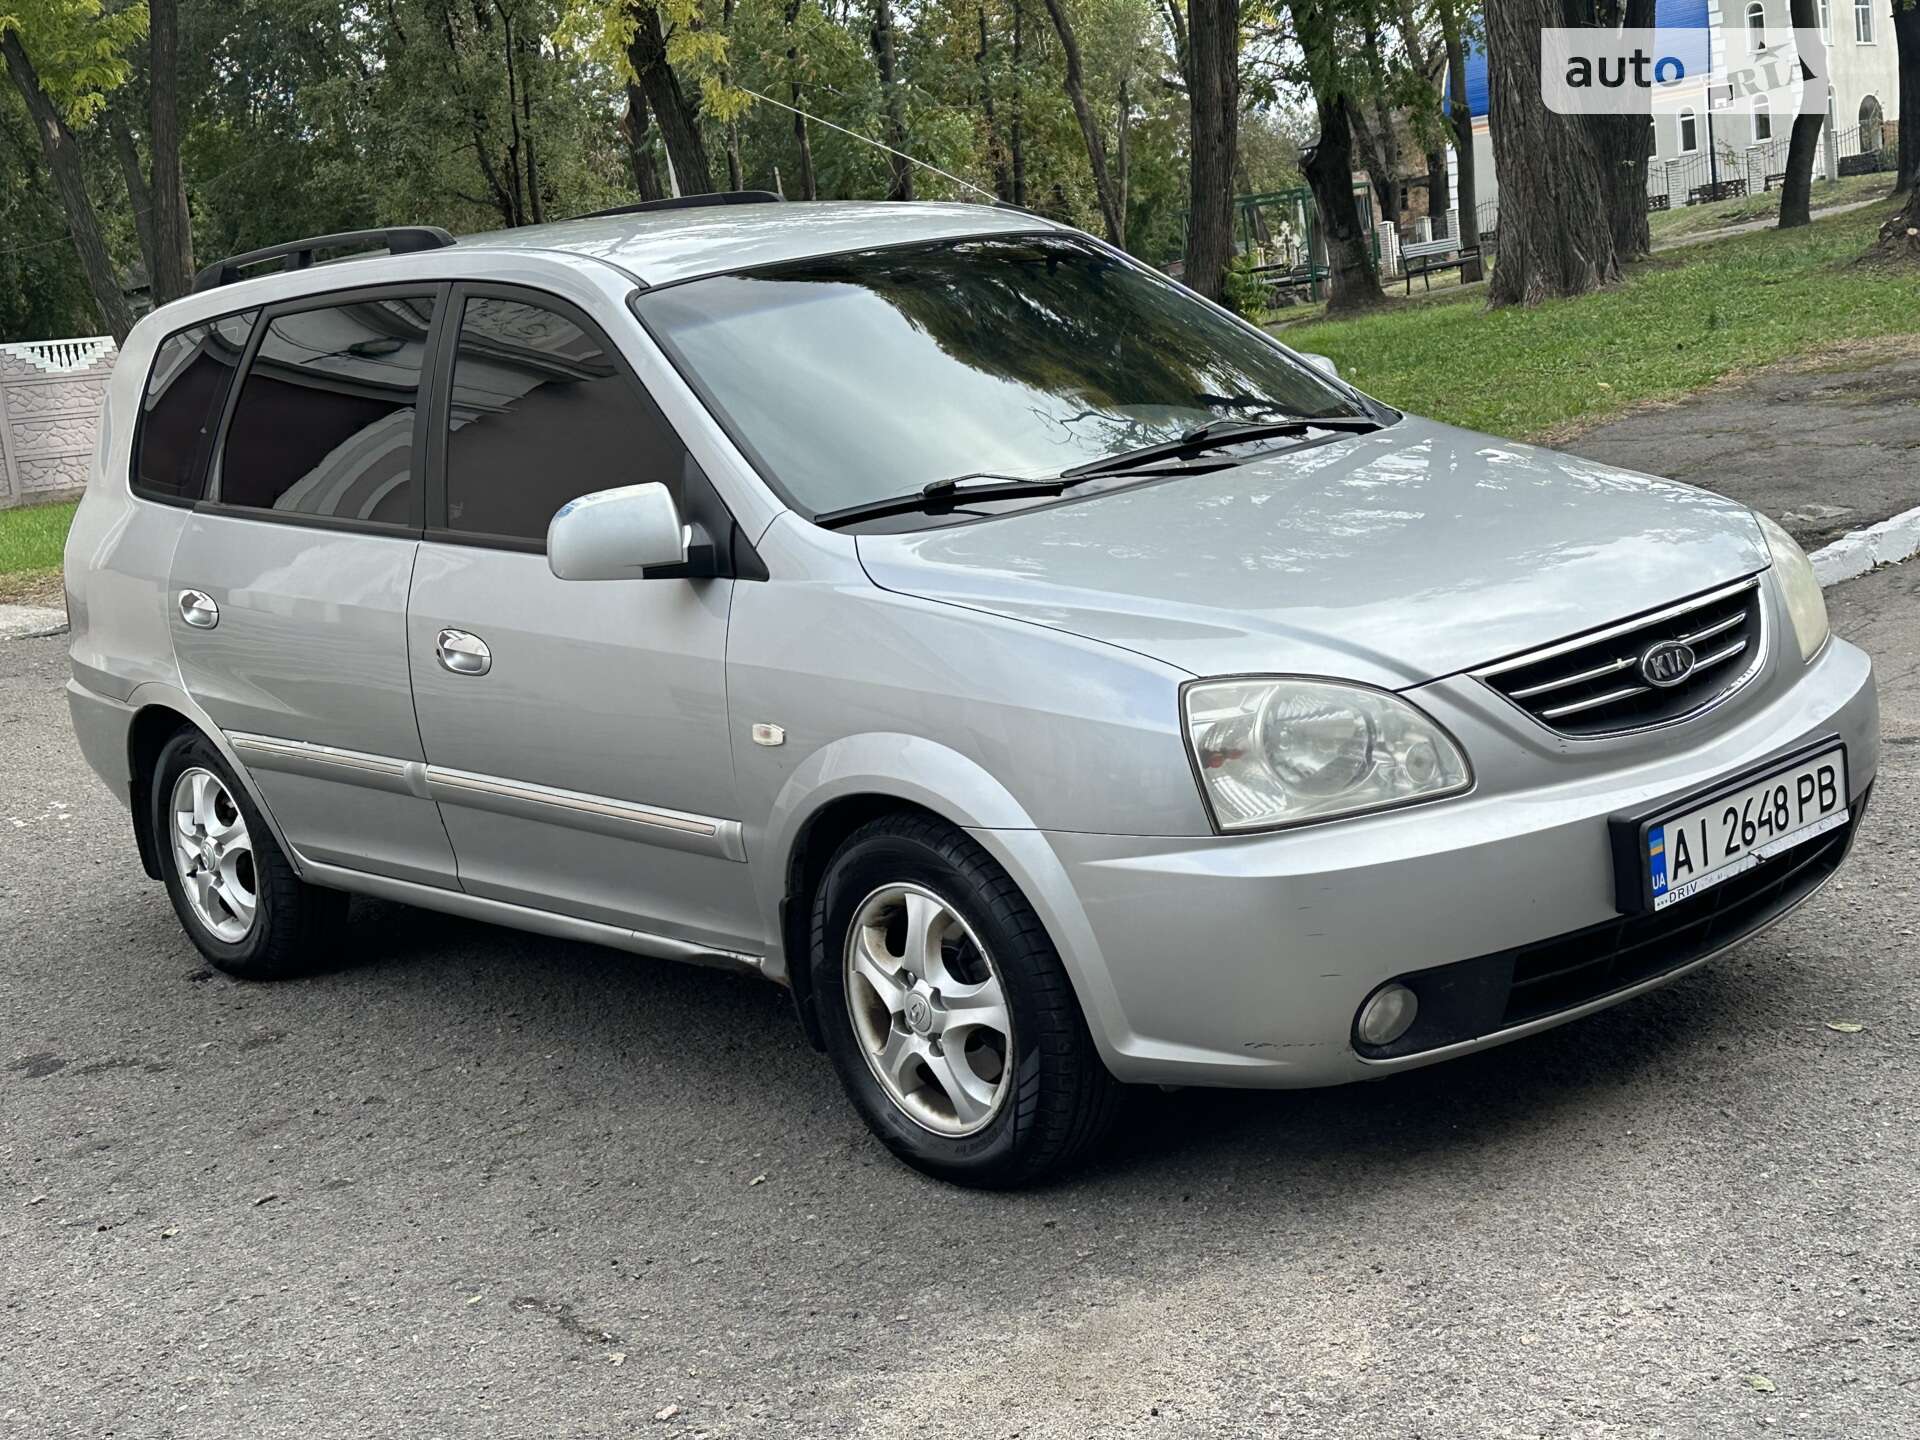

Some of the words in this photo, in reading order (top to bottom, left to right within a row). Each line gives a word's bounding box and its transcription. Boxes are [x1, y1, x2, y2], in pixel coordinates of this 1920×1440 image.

[1650, 648, 1690, 679] KIA
[1672, 818, 1708, 881] AI
[1722, 784, 1789, 857] 2648
[1796, 764, 1837, 824] PB
[1652, 872, 1666, 890] UA
